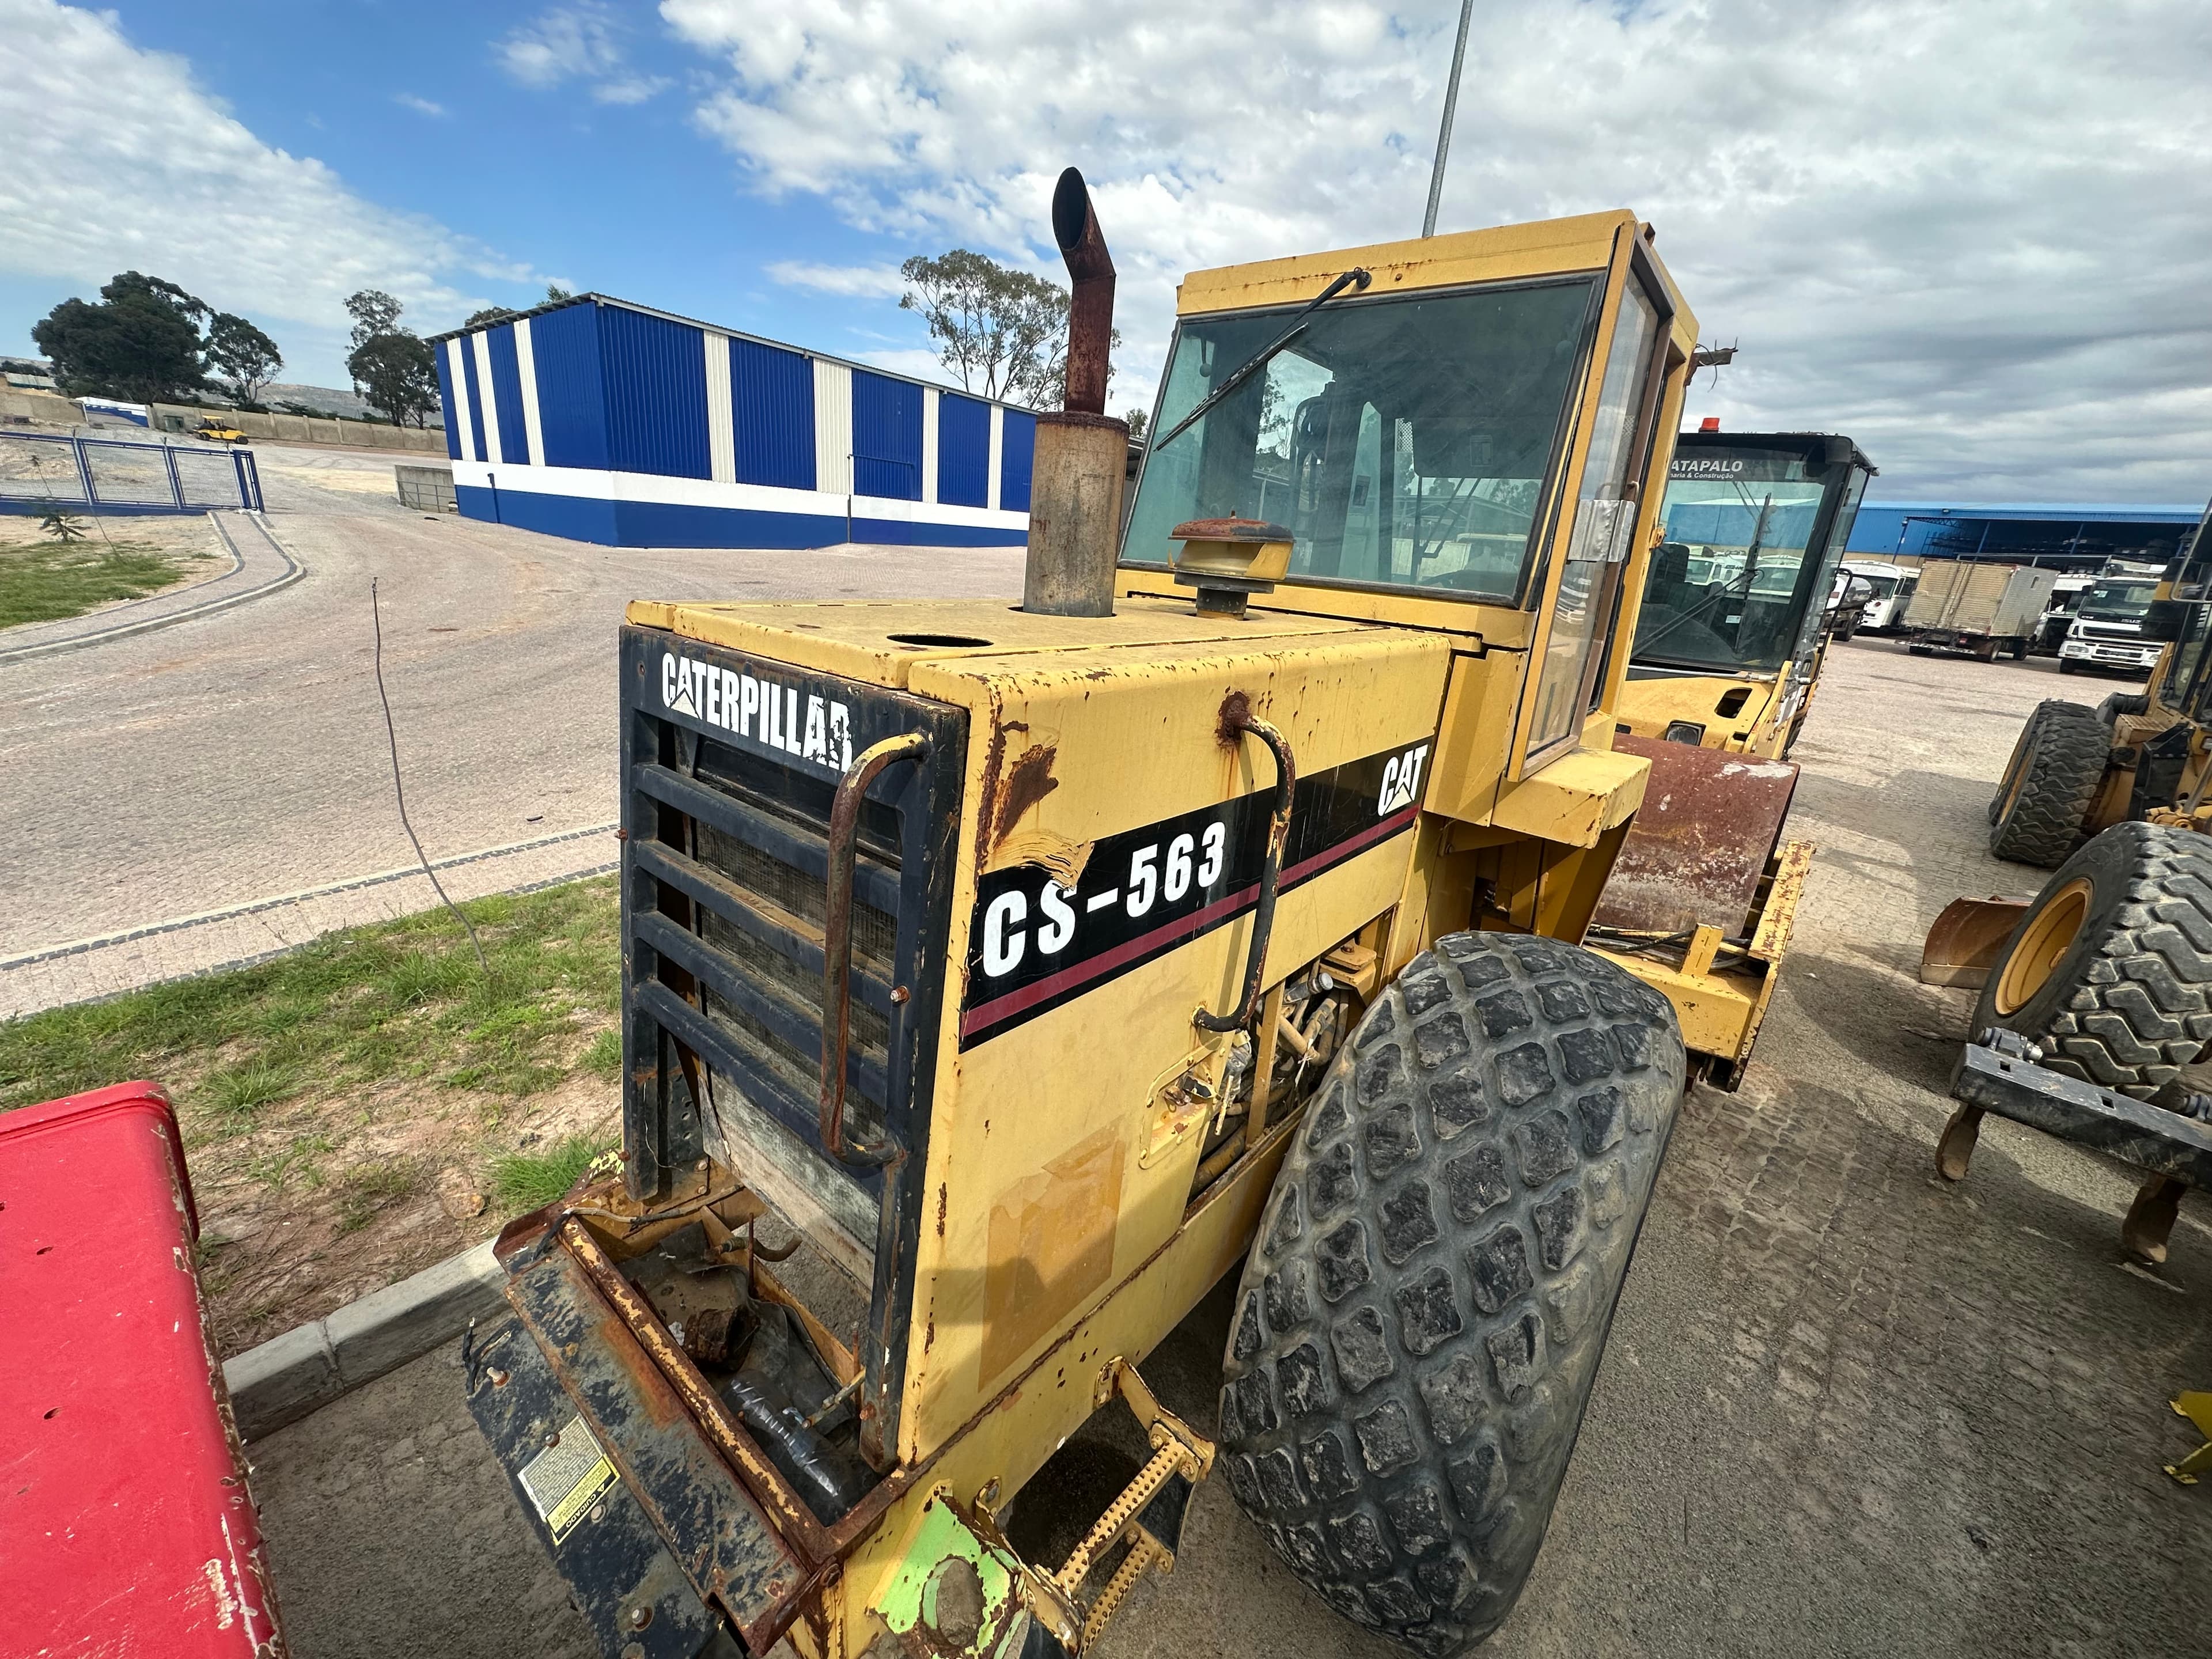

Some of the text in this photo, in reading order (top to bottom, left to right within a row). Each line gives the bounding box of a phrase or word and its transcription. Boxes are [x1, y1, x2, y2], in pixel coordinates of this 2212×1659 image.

[662, 652, 853, 772] CATERPILLAR
[1377, 744, 1429, 817] CAT
[982, 820, 1226, 978] CS-563
[565, 1493, 597, 1528] CUIDADO
